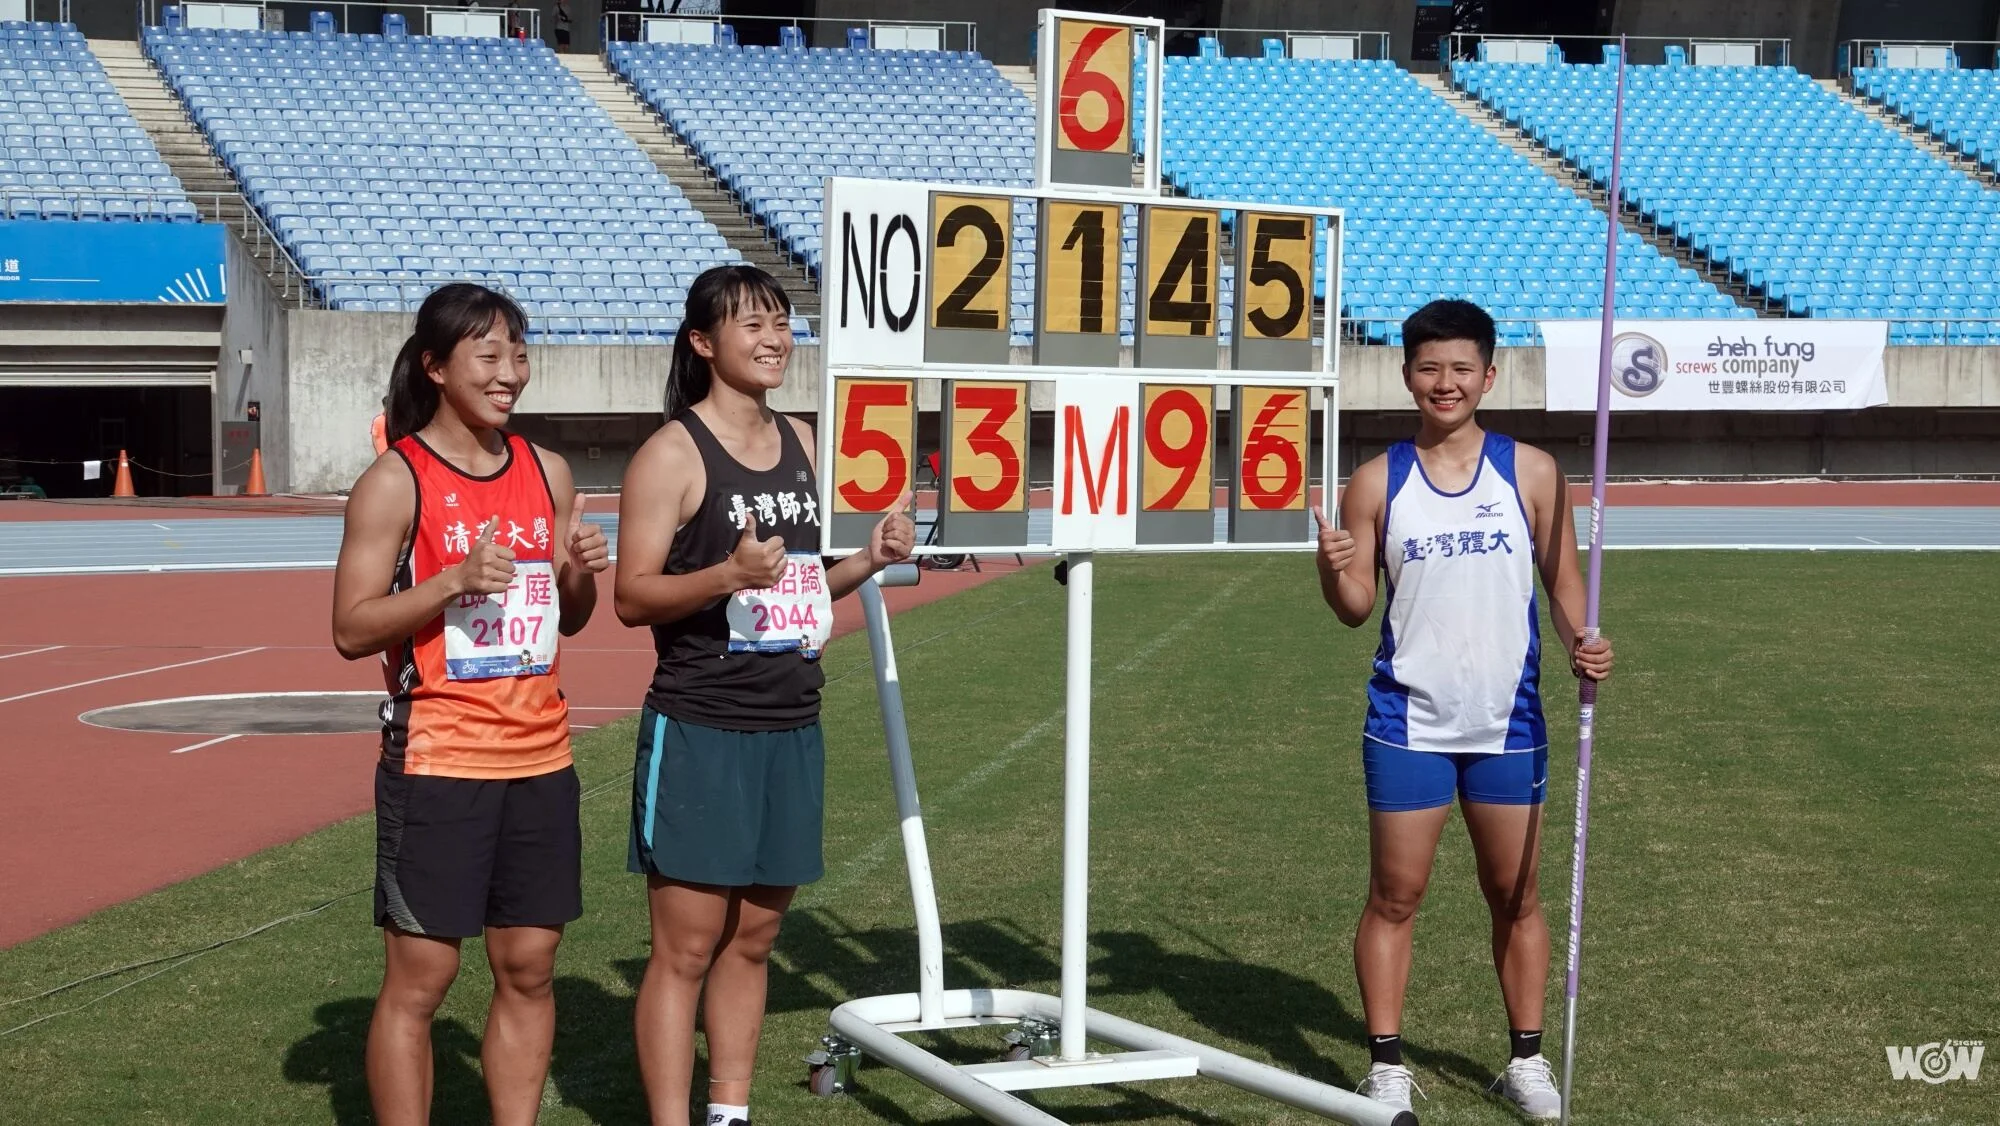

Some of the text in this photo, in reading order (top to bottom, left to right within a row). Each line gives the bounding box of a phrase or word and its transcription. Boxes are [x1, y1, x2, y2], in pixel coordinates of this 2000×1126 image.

[1060, 27, 1124, 152] 6
[0, 258, 20, 273] 道
[840, 211, 921, 333] NO
[1707, 335, 1815, 362] sheh fung
[1676, 358, 1800, 379] screws company
[1708, 380, 1846, 395] 世豐螺絲股份有限公司
[1061, 405, 1129, 515] M
[728, 491, 821, 530] 臺灣師大
[1402, 529, 1513, 564] 臺灣體大
[471, 616, 543, 648] 2107
[752, 604, 818, 632] 2044
